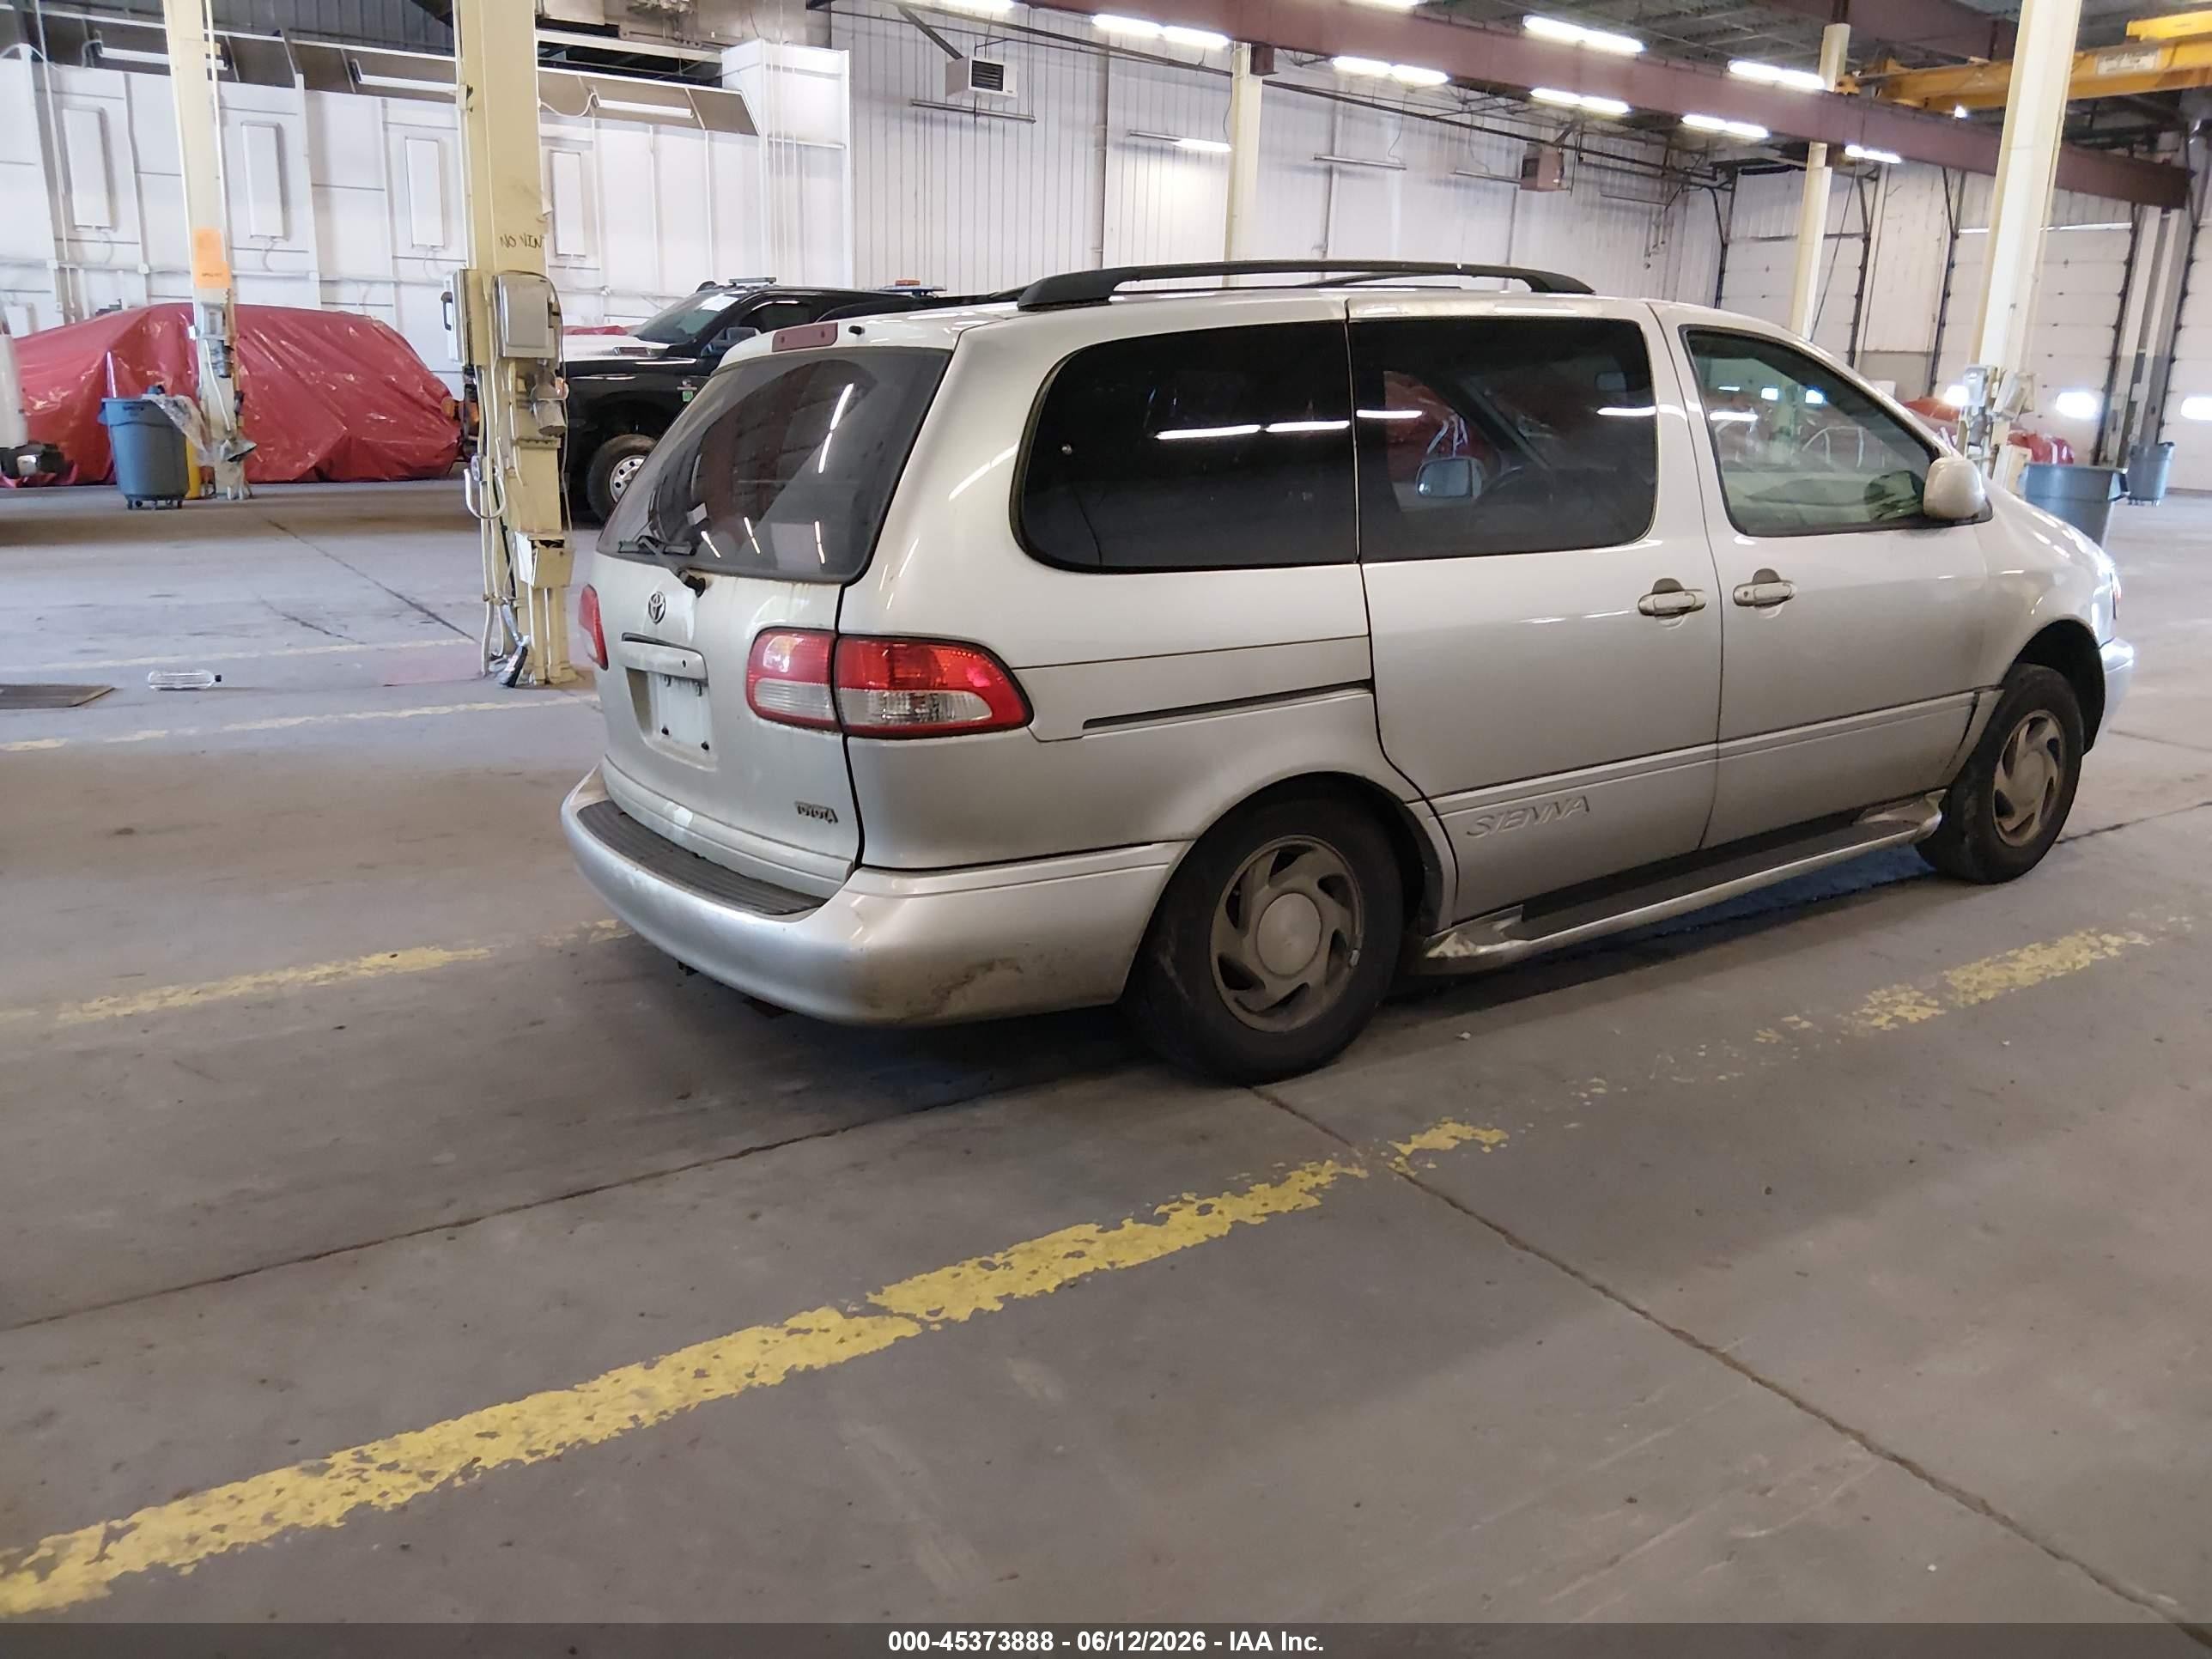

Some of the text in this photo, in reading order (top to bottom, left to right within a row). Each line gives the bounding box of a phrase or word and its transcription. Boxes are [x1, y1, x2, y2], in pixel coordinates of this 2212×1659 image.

[500, 232, 543, 249] NO VIN
[1466, 795, 1590, 839] SIENNA
